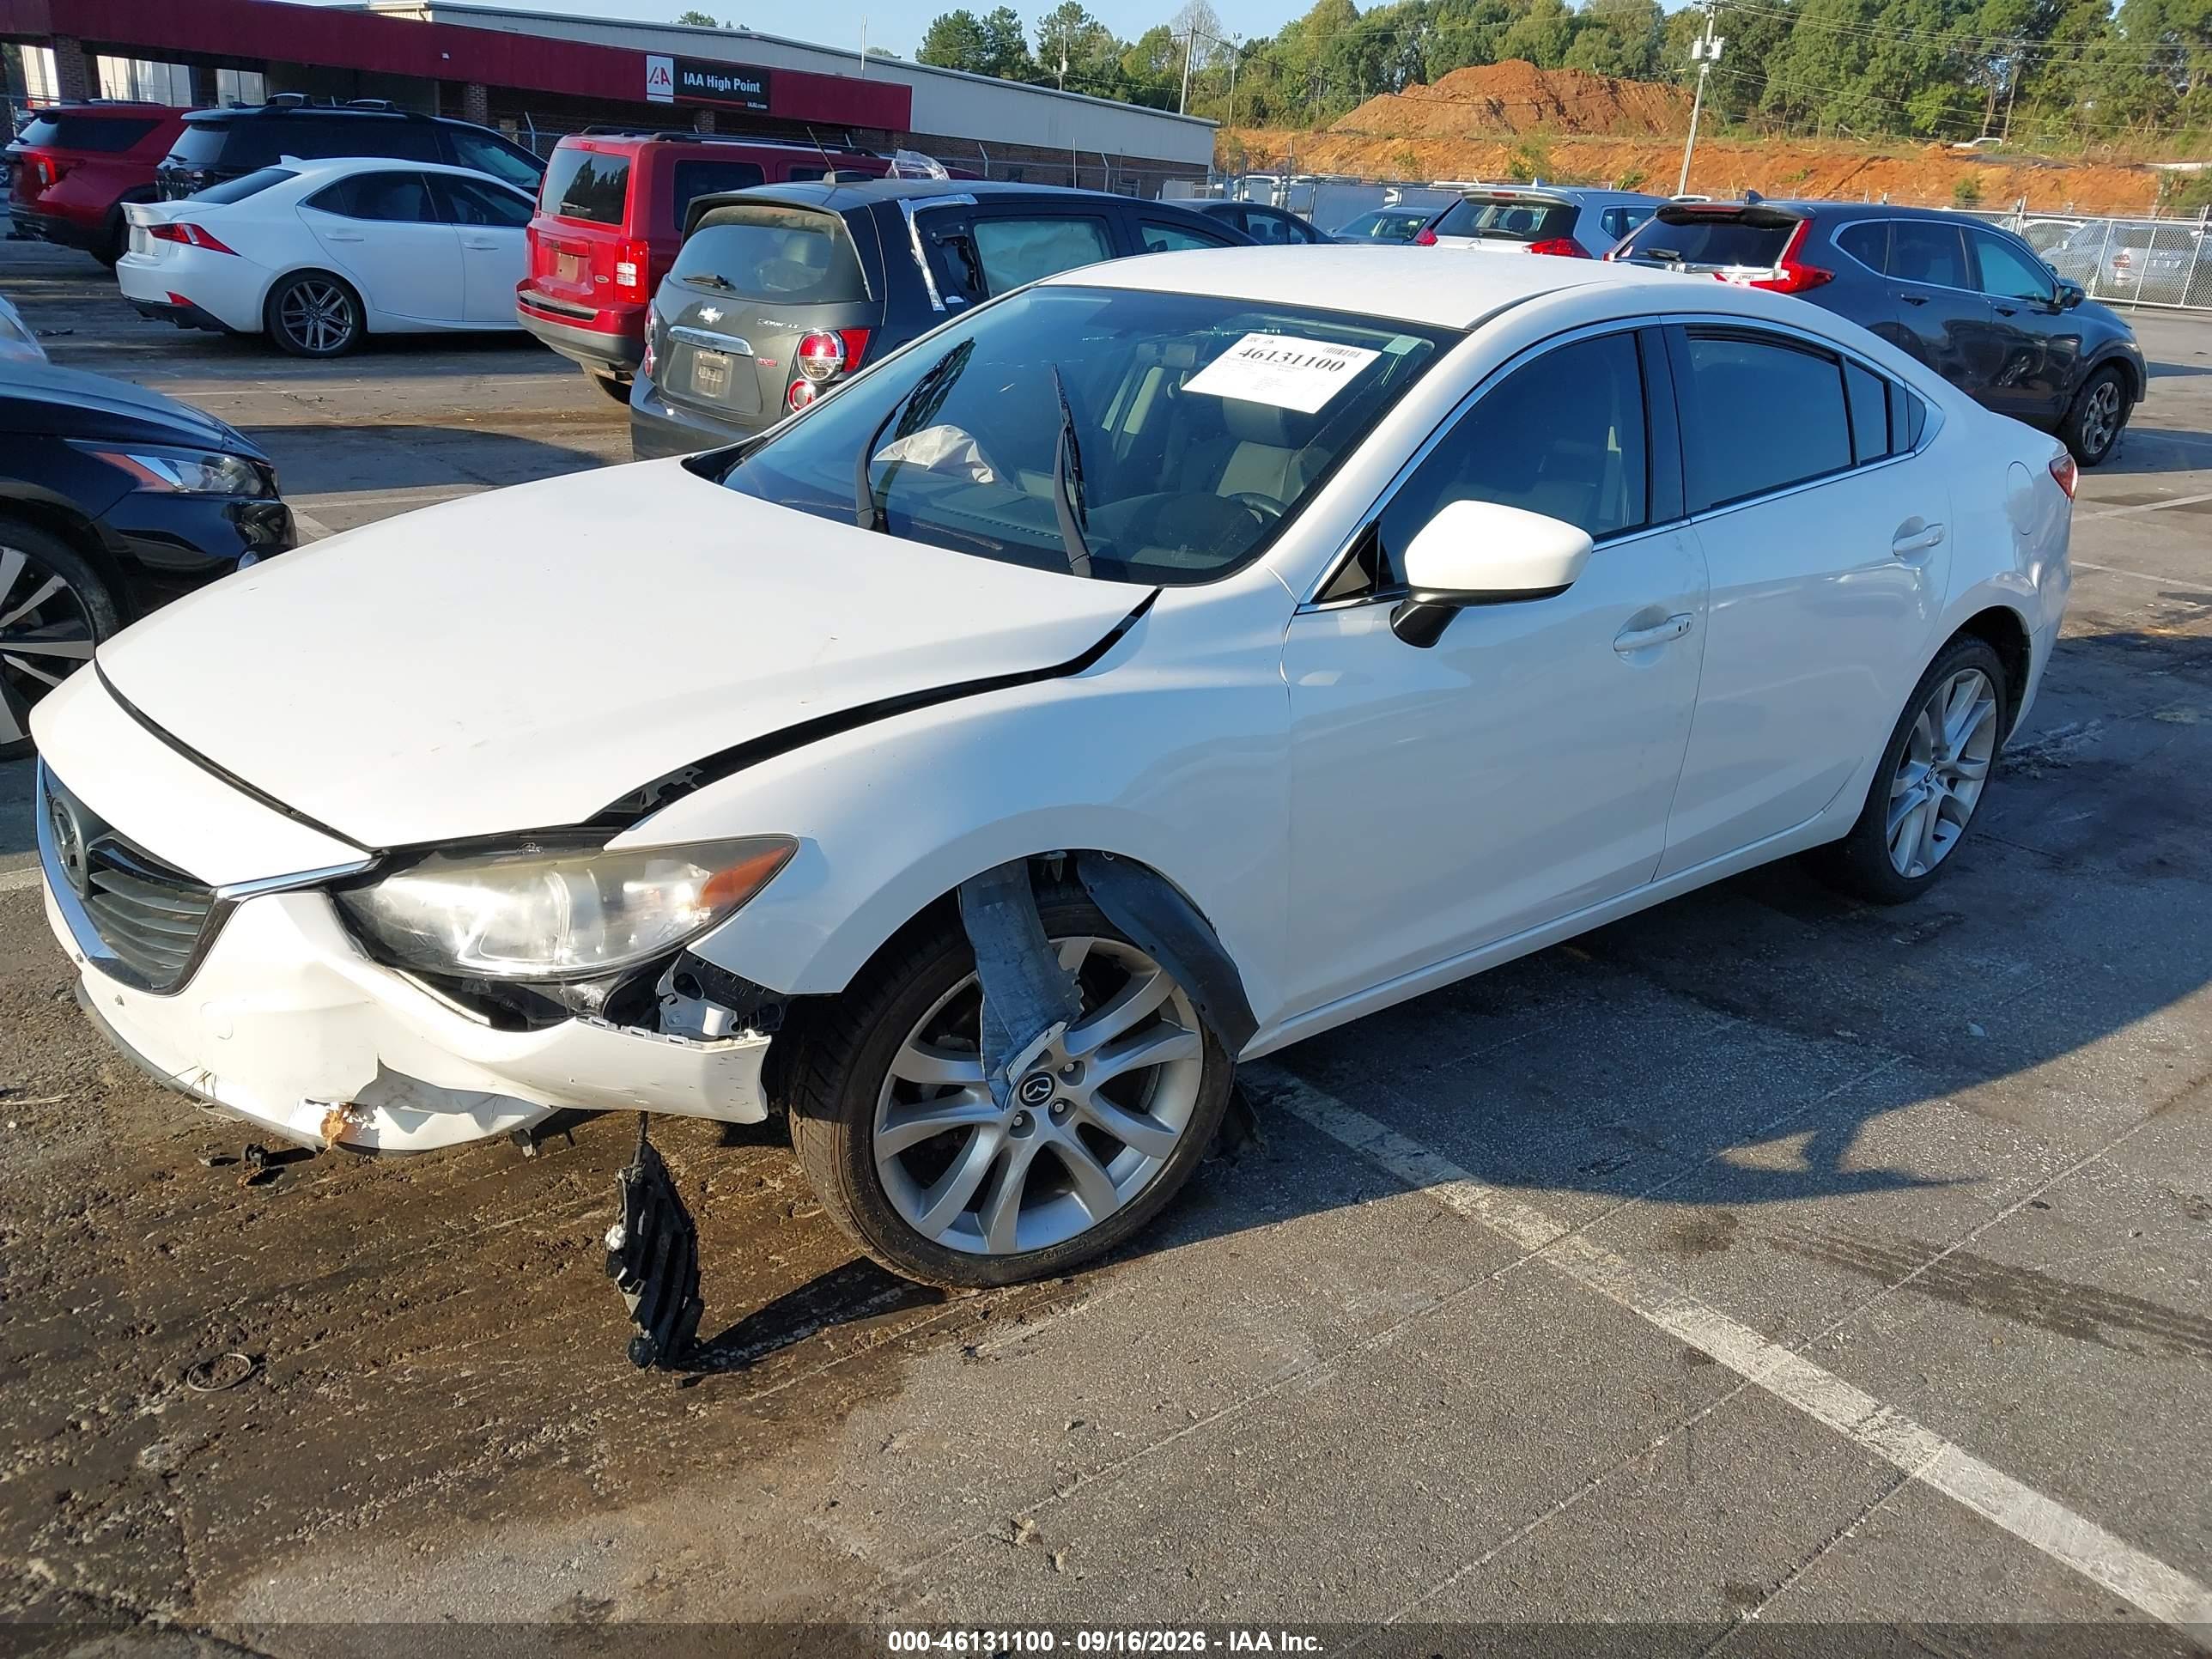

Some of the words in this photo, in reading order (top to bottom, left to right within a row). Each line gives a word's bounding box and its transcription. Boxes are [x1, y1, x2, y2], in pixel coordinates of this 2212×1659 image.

[684, 71, 705, 87] IAA
[707, 75, 731, 92] High
[733, 78, 761, 93] Point
[1238, 347, 1346, 373] 46131100
